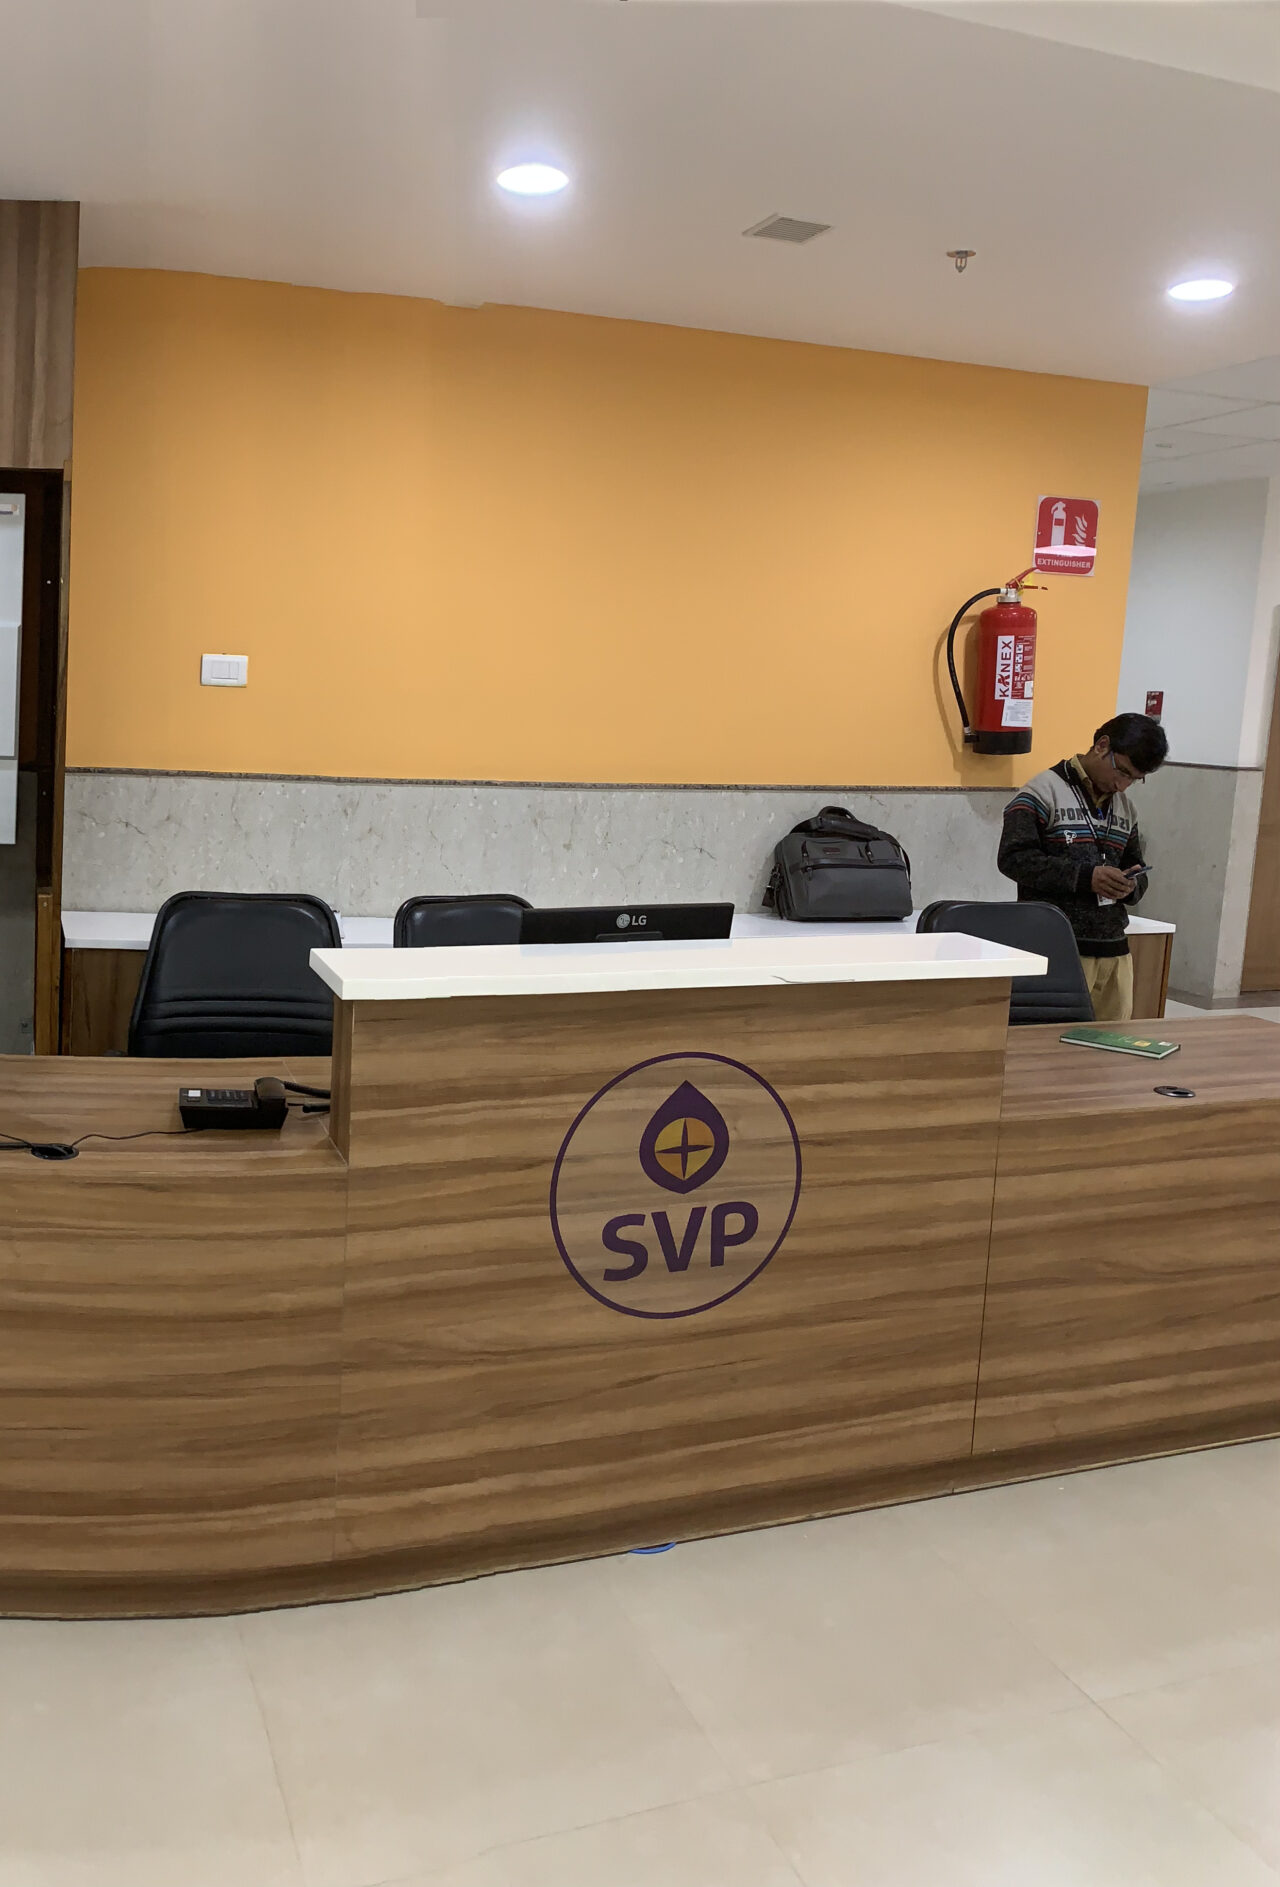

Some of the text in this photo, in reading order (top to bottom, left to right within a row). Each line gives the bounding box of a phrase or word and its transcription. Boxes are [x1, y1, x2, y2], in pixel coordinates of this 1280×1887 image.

[1037, 557, 1091, 569] EXTINGUISHER
[998, 640, 1012, 698] KANEX
[631, 915, 647, 926] LG
[601, 1201, 759, 1282] SVP
